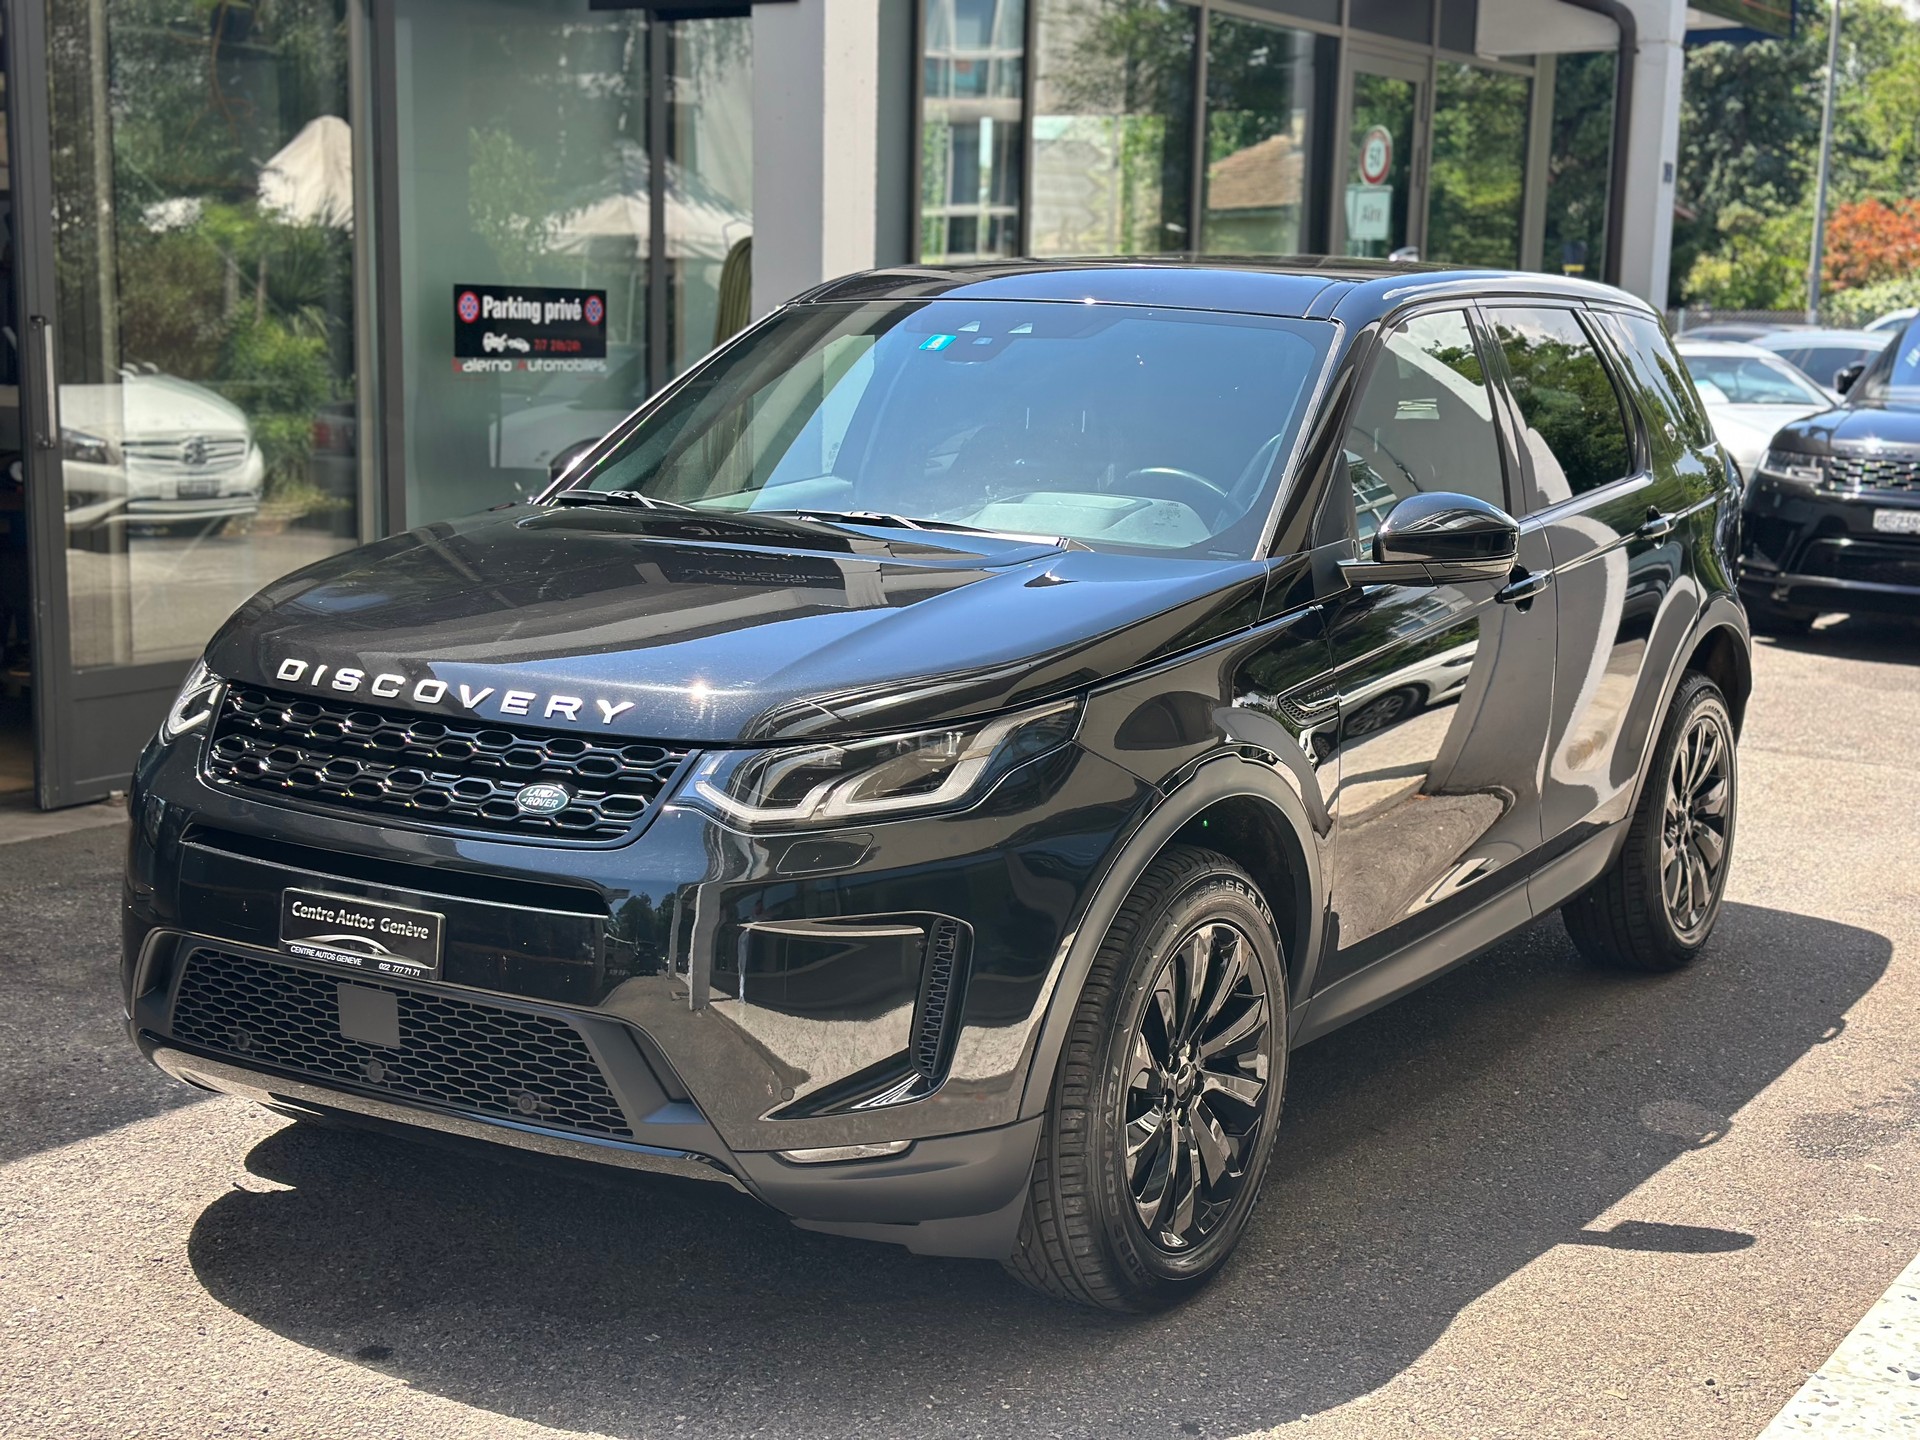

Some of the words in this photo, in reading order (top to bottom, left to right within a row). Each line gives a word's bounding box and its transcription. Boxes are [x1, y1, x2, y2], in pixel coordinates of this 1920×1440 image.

[482, 295, 541, 325] Parking
[544, 298, 582, 325] privé
[517, 358, 607, 373] Automobiles
[276, 658, 635, 725] DISCOVERY
[526, 788, 554, 798] LAND
[525, 797, 559, 808] ROVER
[291, 901, 334, 923] Centre
[335, 909, 376, 930] Autos
[380, 917, 429, 940] Genève
[290, 945, 316, 957] CENTRE
[315, 951, 336, 962] AUTOS
[378, 963, 391, 971] 022
[392, 965, 404, 973] 777
